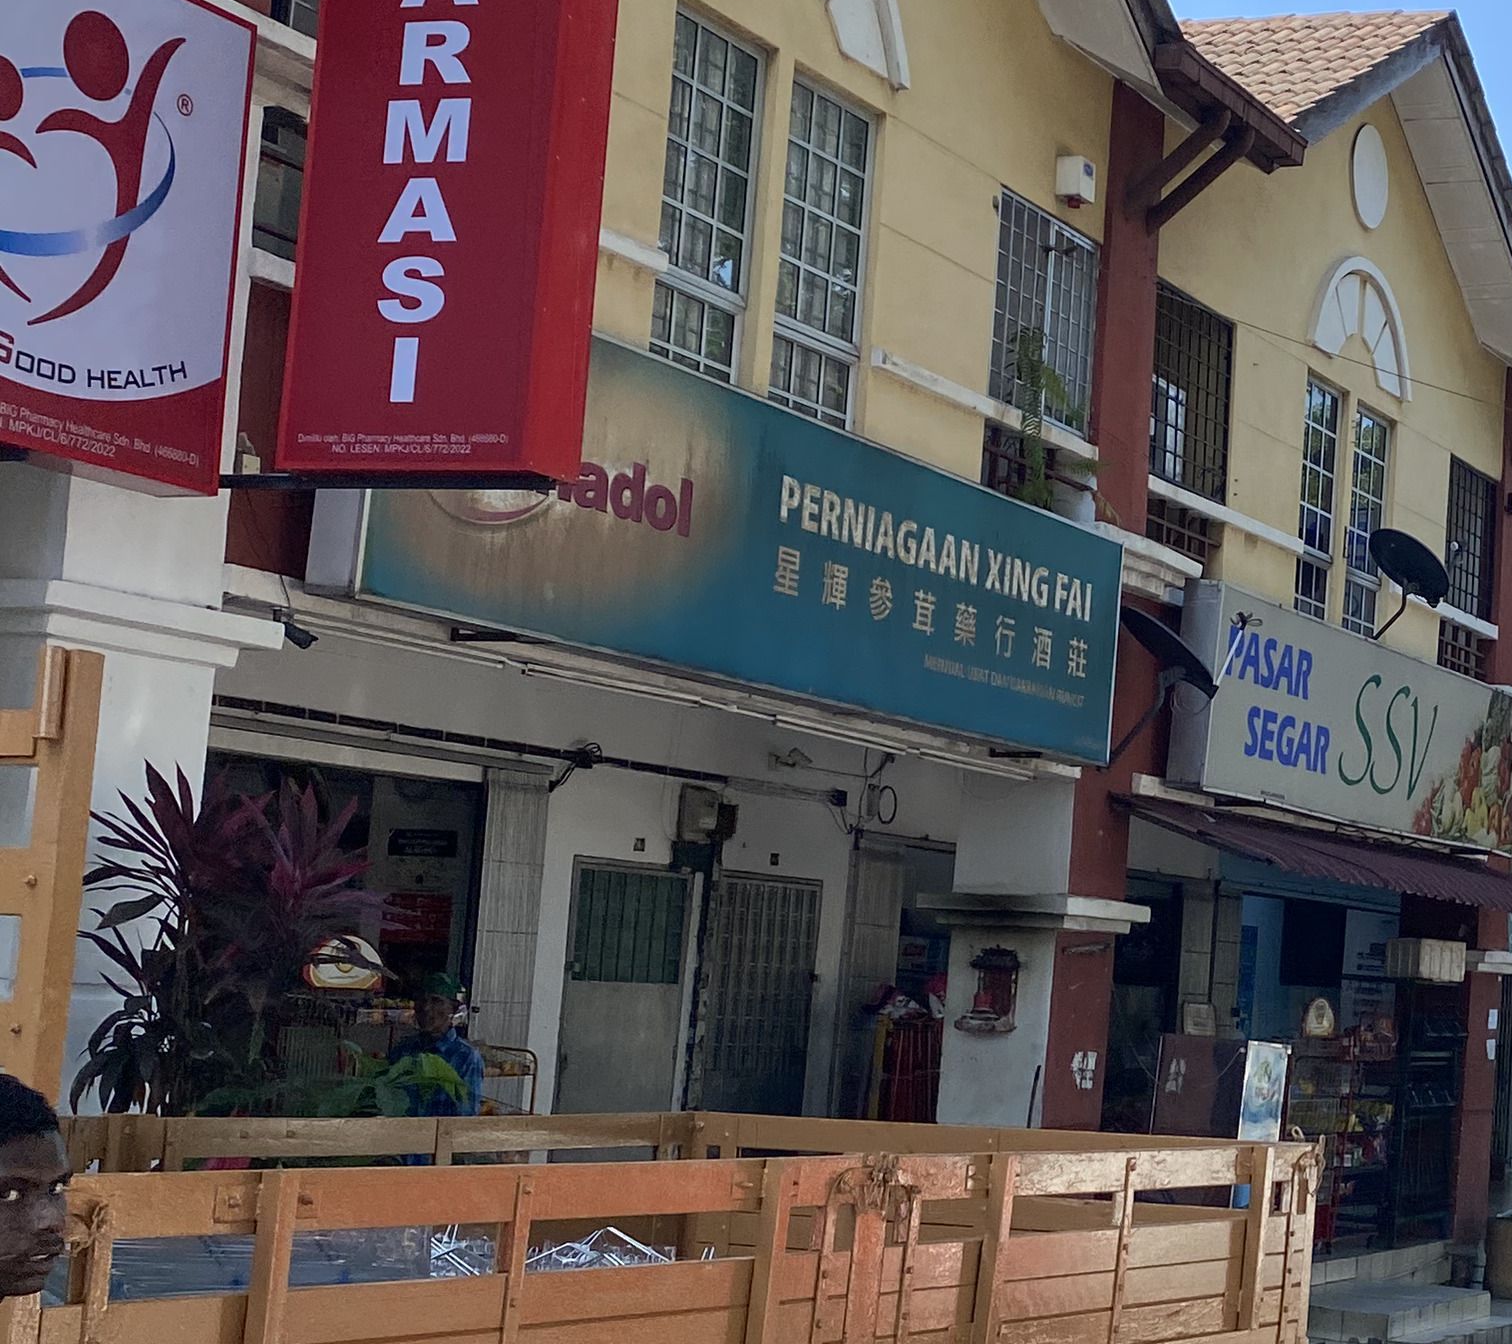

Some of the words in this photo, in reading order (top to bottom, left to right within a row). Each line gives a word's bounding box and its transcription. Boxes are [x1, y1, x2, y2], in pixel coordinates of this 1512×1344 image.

[87, 361, 188, 390] HEALTH
[20, 407, 65, 432] Pharmacy
[65, 419, 112, 442] Healthcare
[778, 474, 980, 586] PERNIAGAAN
[984, 549, 1049, 608] XING
[1053, 571, 1093, 623] FAI
[1225, 624, 1313, 700] PASAR
[1338, 674, 1439, 800] SSV
[1243, 706, 1330, 774] SEGAR
